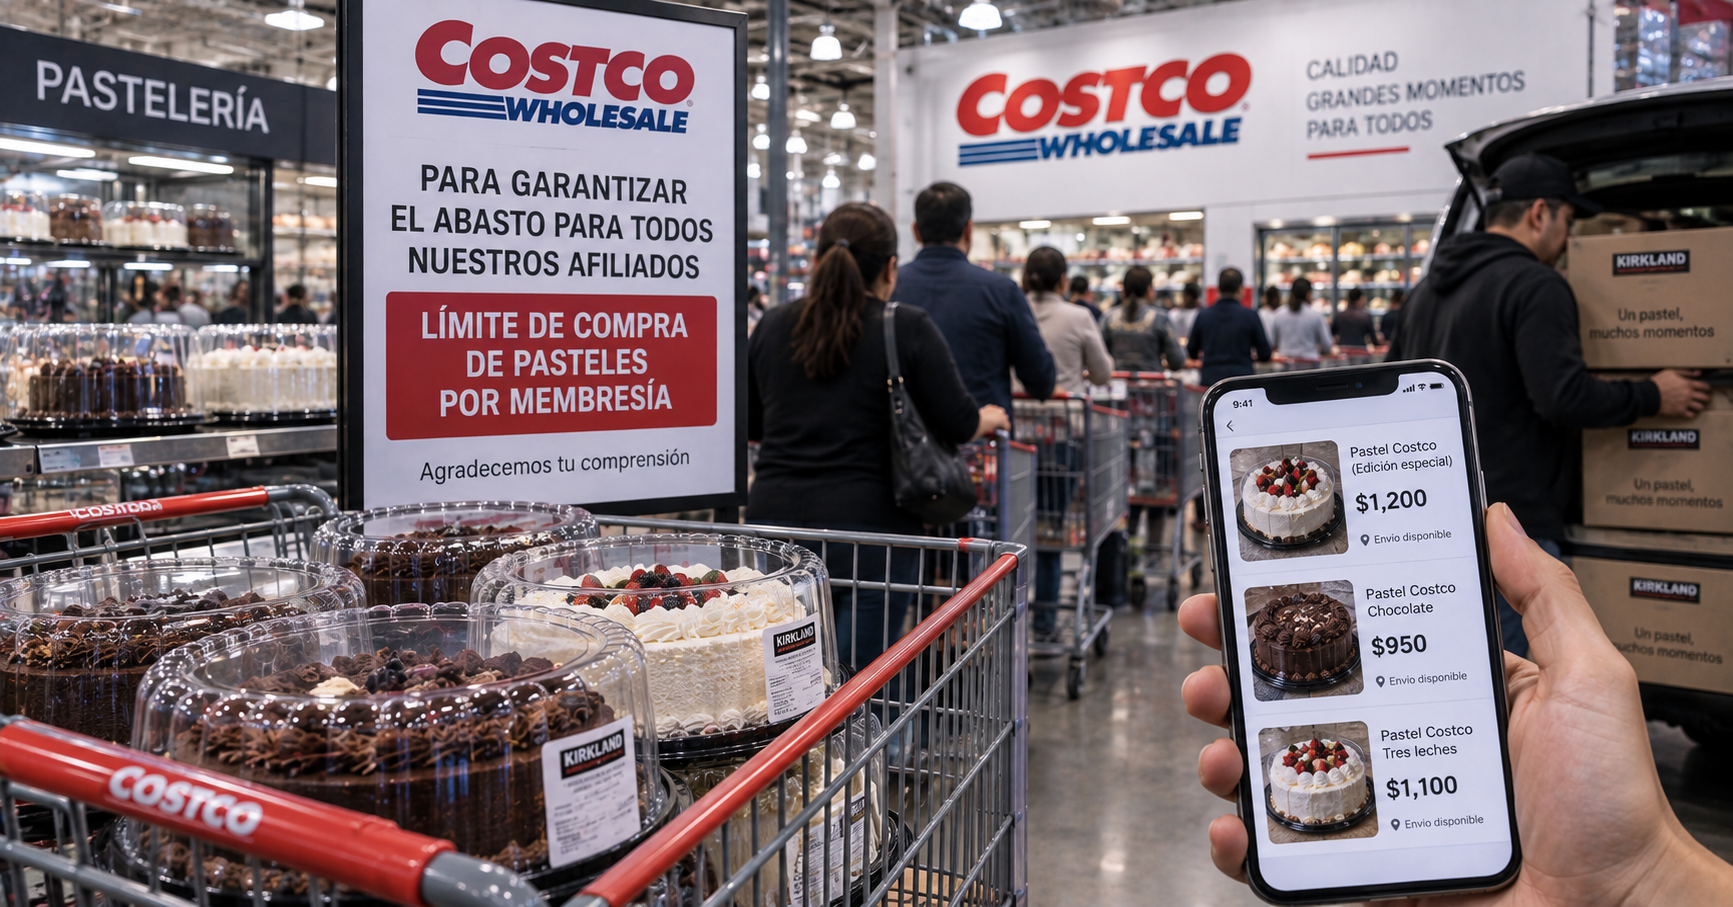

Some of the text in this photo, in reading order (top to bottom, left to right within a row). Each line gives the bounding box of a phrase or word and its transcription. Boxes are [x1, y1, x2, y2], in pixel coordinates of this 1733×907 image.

[414, 19, 695, 105] COSTCO
[1306, 50, 1398, 81] CALIDAD
[36, 59, 270, 134] PASTELERÍA
[956, 53, 1252, 137] COSTCO
[1306, 70, 1526, 112] GRANDES MOMENTOS
[504, 96, 689, 134] WHOLESALE
[1306, 109, 1433, 140] PARA TODOS
[1039, 117, 1242, 161] WHOLESALE
[420, 164, 688, 205] PARA GARANTIZAR
[391, 204, 713, 243] EL ABASTO PARA TODOS
[408, 246, 700, 280] NUESTROS AFILIADOS
[1616, 252, 1686, 268] KIRKLAND
[421, 304, 689, 340] LÍMITE DE COMPRA
[1617, 307, 1683, 323] Un pastel,
[1589, 325, 1715, 340] muchos momentos
[466, 348, 648, 378] DE PASTELES
[440, 378, 673, 417] POR MEMBRESÍA
[1232, 399, 1253, 409] 9:41
[1631, 430, 1697, 443] KIRKLAND
[1350, 440, 1437, 458] Pastel Costco
[420, 448, 690, 485] Agradecemos tu comprensión
[1351, 454, 1453, 476] (Edición especial)
[1633, 478, 1650, 490] Un
[1355, 488, 1427, 513] $1,200
[1605, 493, 1723, 509] muchos momentos
[1402, 529, 1452, 544] disponible
[1365, 582, 1456, 600] Pastel Costco
[1633, 579, 1698, 596] KIRKLAND
[1367, 601, 1434, 618] Chocolate
[776, 625, 814, 647] KIRKLAND
[1634, 626, 1651, 640] Un
[1371, 634, 1427, 658] $950
[1656, 645, 1723, 665] momentos
[1417, 670, 1468, 686] disponible
[1380, 724, 1473, 742] Pastel Costco
[564, 733, 623, 767] KIRKLAND
[1382, 743, 1458, 760] Tres leches
[1386, 775, 1458, 800] $1,100
[108, 765, 264, 837] COSTCO
[1433, 814, 1485, 829] disponible
